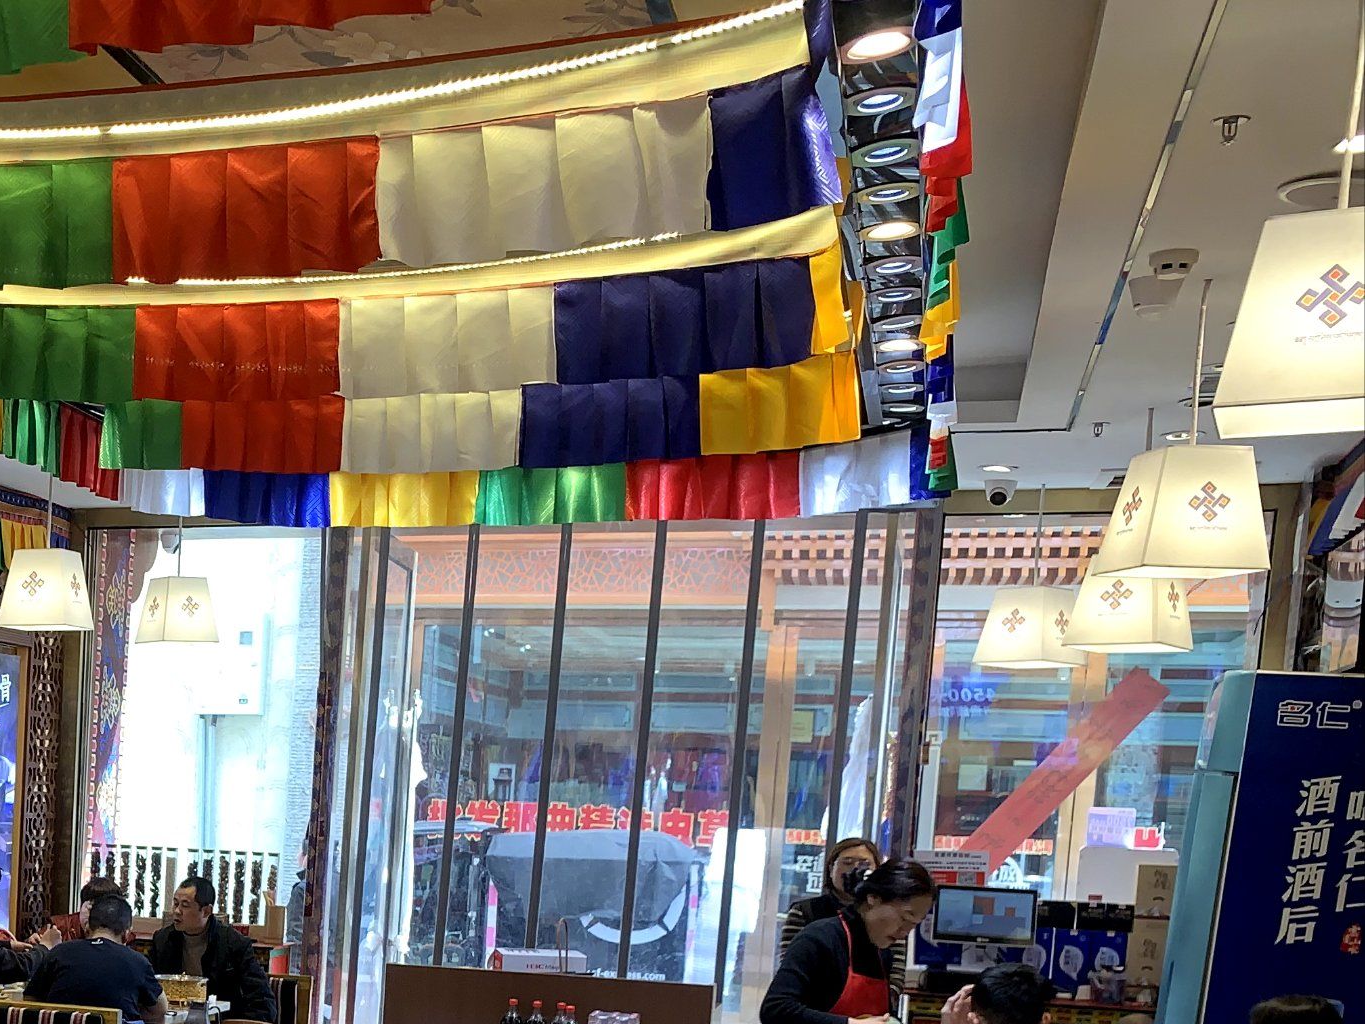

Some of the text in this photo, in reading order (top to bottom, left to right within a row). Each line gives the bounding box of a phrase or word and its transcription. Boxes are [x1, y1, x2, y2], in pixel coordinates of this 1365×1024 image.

[1277, 700, 1351, 729] 名仁
[1274, 776, 1342, 945] 酒前酒后
